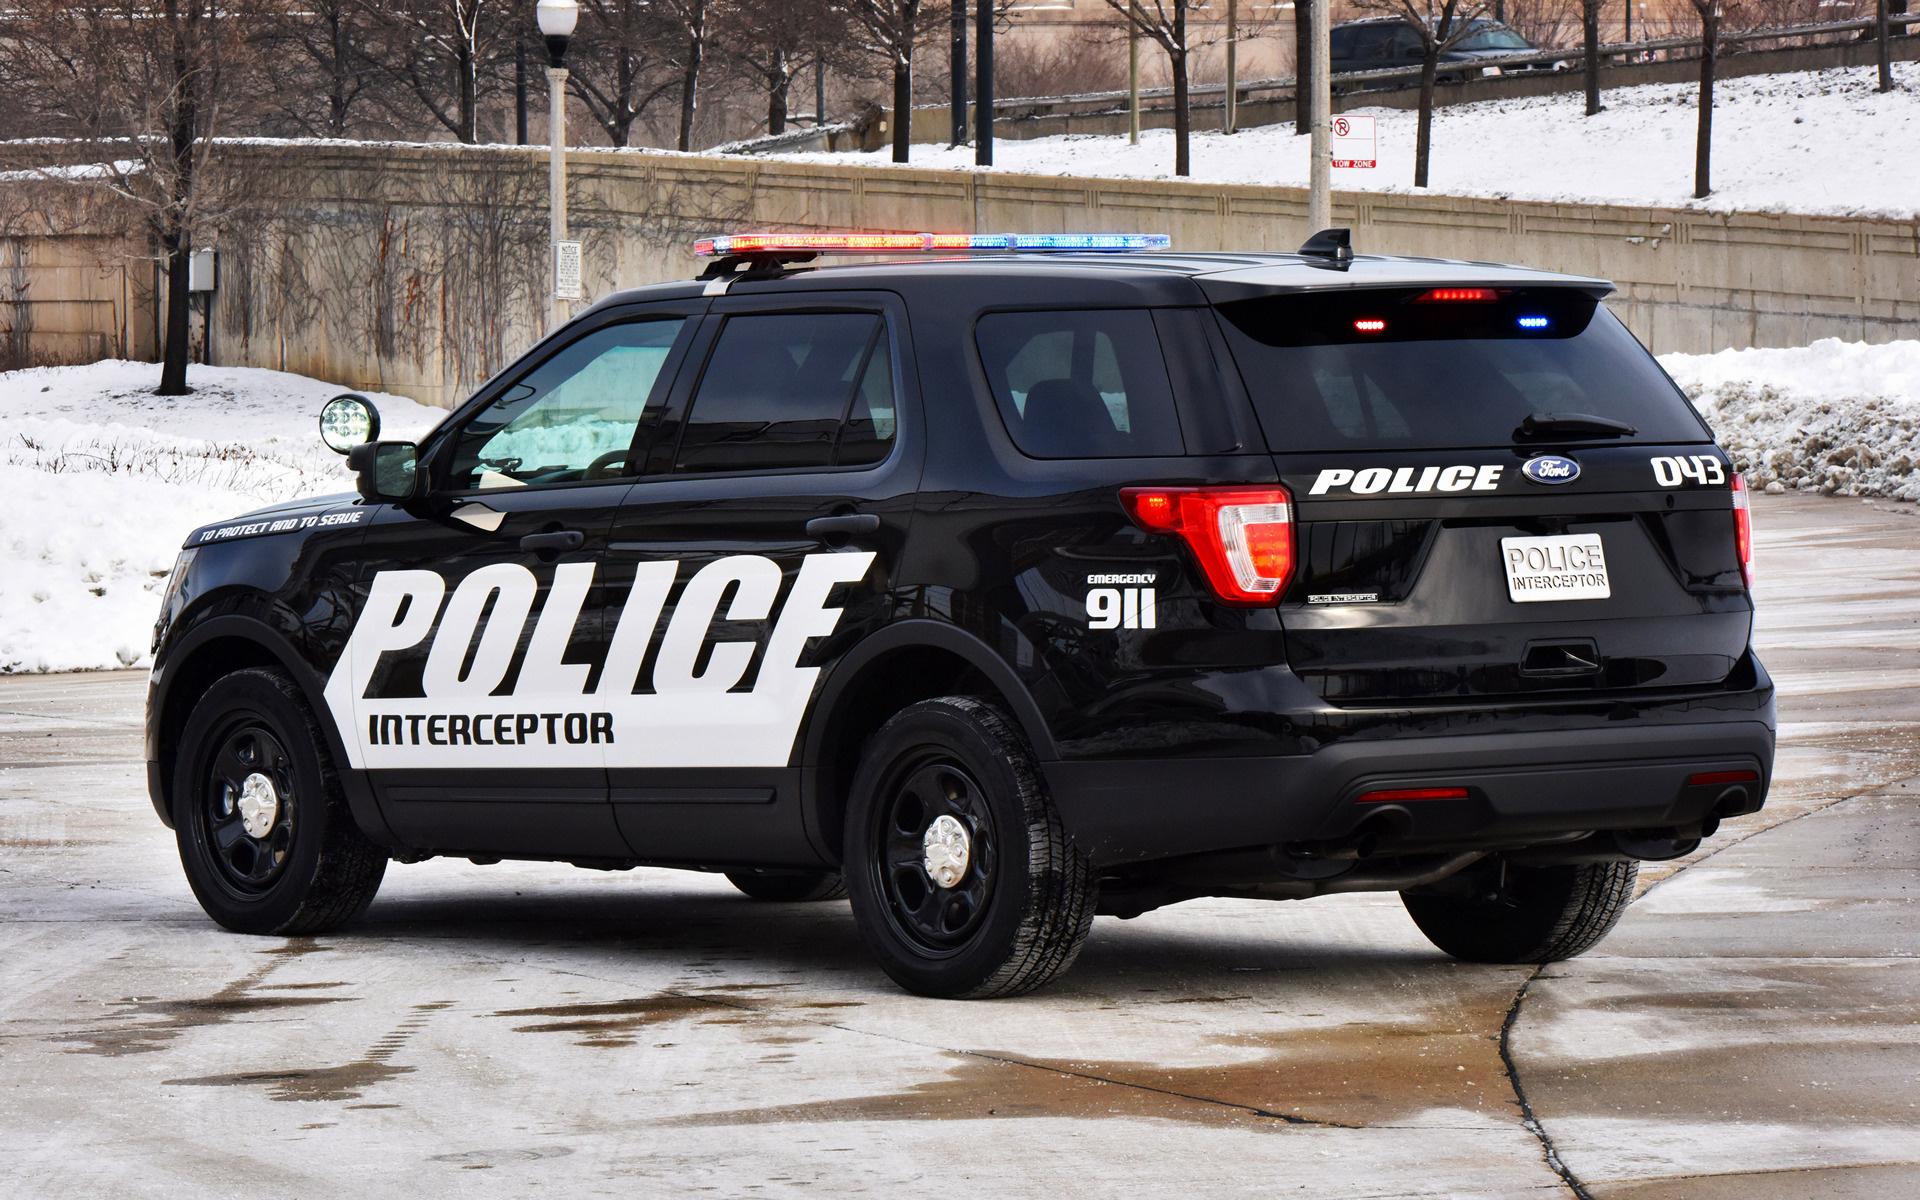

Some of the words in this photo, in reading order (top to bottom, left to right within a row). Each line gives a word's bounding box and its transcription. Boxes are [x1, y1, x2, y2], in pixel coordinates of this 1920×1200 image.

[1308, 465, 1504, 495] POLICE
[1539, 460, 1570, 477] Ford
[1650, 455, 1725, 487] 043
[200, 531, 214, 542] TO
[215, 522, 270, 539] PROTECT
[269, 518, 298, 532] AND
[300, 516, 318, 528] TO
[318, 511, 364, 526] SERVE
[1507, 545, 1604, 573] POLICE
[1087, 574, 1156, 584] EMERGENCY
[1512, 573, 1606, 590] INTERCEPTOR
[1086, 588, 1156, 629] 911
[323, 552, 877, 699] POLICE
[369, 712, 614, 745] INTERCEPTOR
